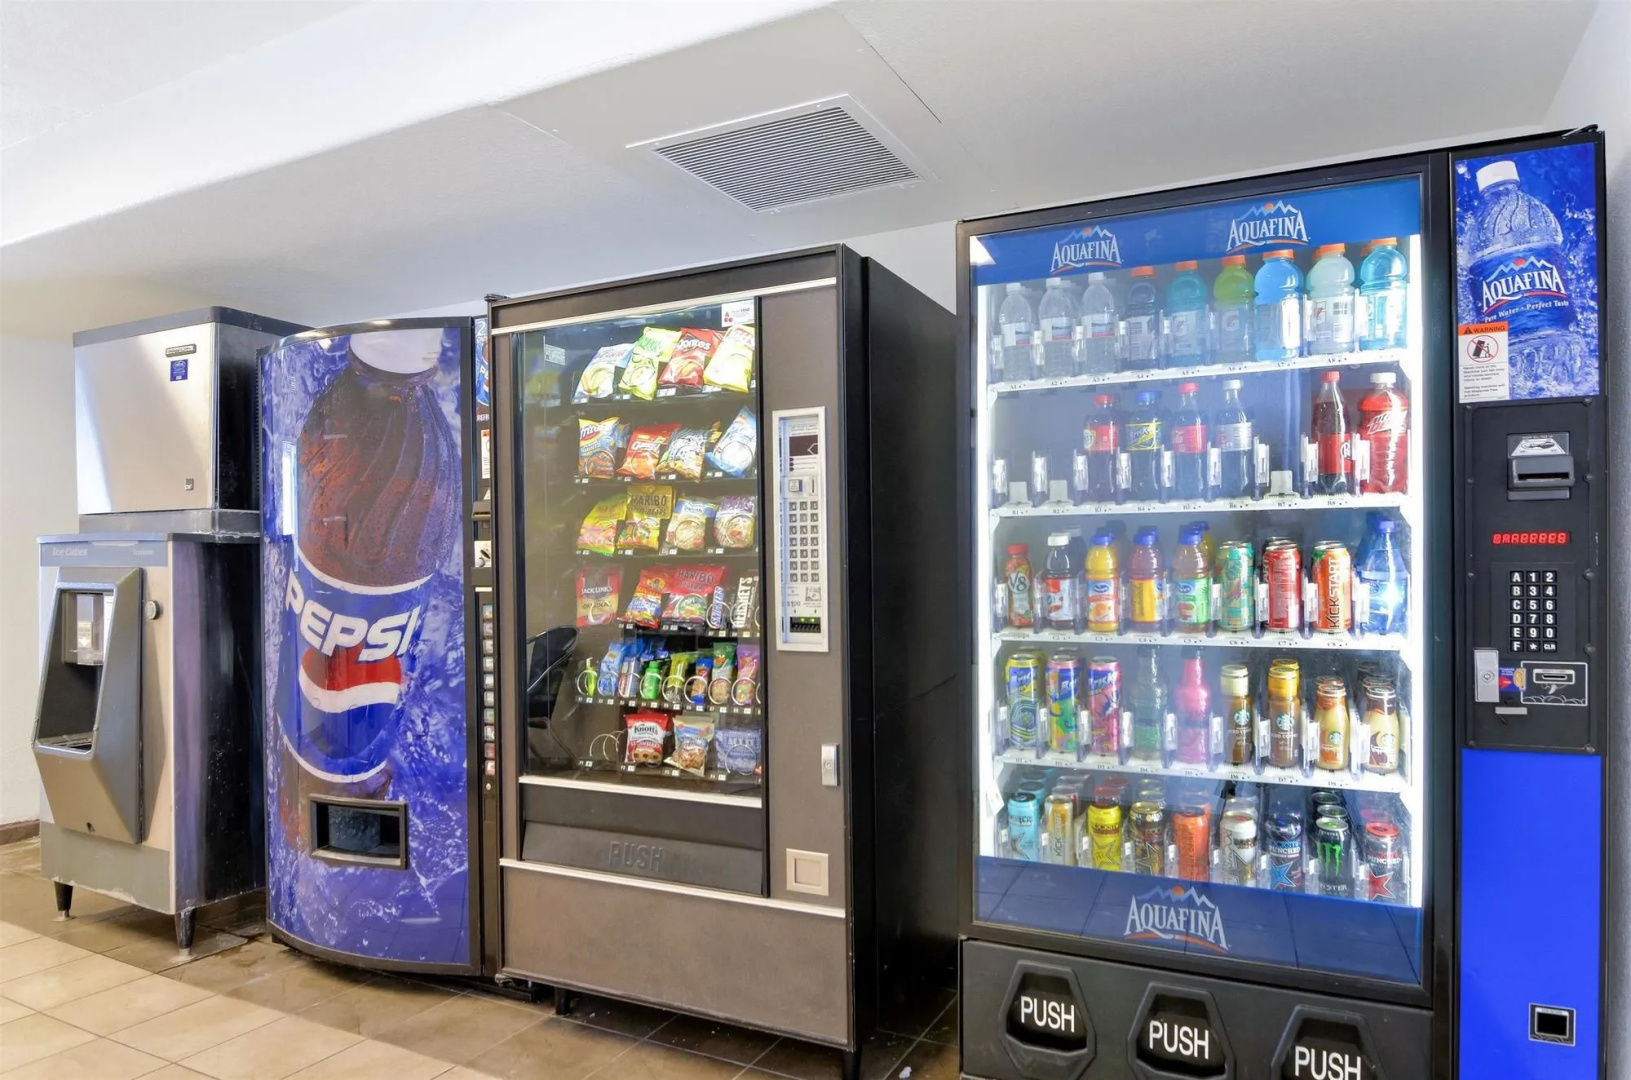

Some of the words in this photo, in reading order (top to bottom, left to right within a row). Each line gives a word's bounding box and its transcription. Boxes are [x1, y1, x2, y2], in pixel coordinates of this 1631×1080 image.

[1226, 210, 1309, 252] AQUAFINA
[1049, 233, 1122, 273] AQUAFINA
[1483, 265, 1567, 313] AQUAFINA
[1498, 307, 1520, 317] Water
[1526, 301, 1552, 310] Perfect
[1473, 325, 1506, 334] WARNING
[1009, 571, 1027, 592] V8
[1512, 572, 1521, 582] A
[1529, 572, 1536, 582] 1
[1545, 572, 1554, 582] 2
[582, 587, 595, 595] JACK
[1325, 557, 1340, 628] KICKSTART
[1512, 586, 1521, 596] B
[1529, 586, 1537, 596] 3
[1545, 586, 1554, 596] 4
[1512, 600, 1521, 610] C
[1529, 600, 1537, 610] 5
[1545, 600, 1554, 610] 6
[285, 567, 421, 662] PEPSI
[1512, 614, 1521, 624] D
[1529, 614, 1537, 623] 7
[1545, 614, 1554, 624] 8
[1513, 628, 1521, 638] E
[1529, 628, 1537, 638] 9
[1546, 628, 1554, 638] 0
[1513, 641, 1521, 651] F
[608, 841, 664, 873] PUSH
[1123, 895, 1230, 949] AQUAFINA
[1020, 995, 1075, 1033] PUSH
[1149, 1019, 1210, 1060] PUSH
[1294, 1045, 1362, 1080] PUSH
